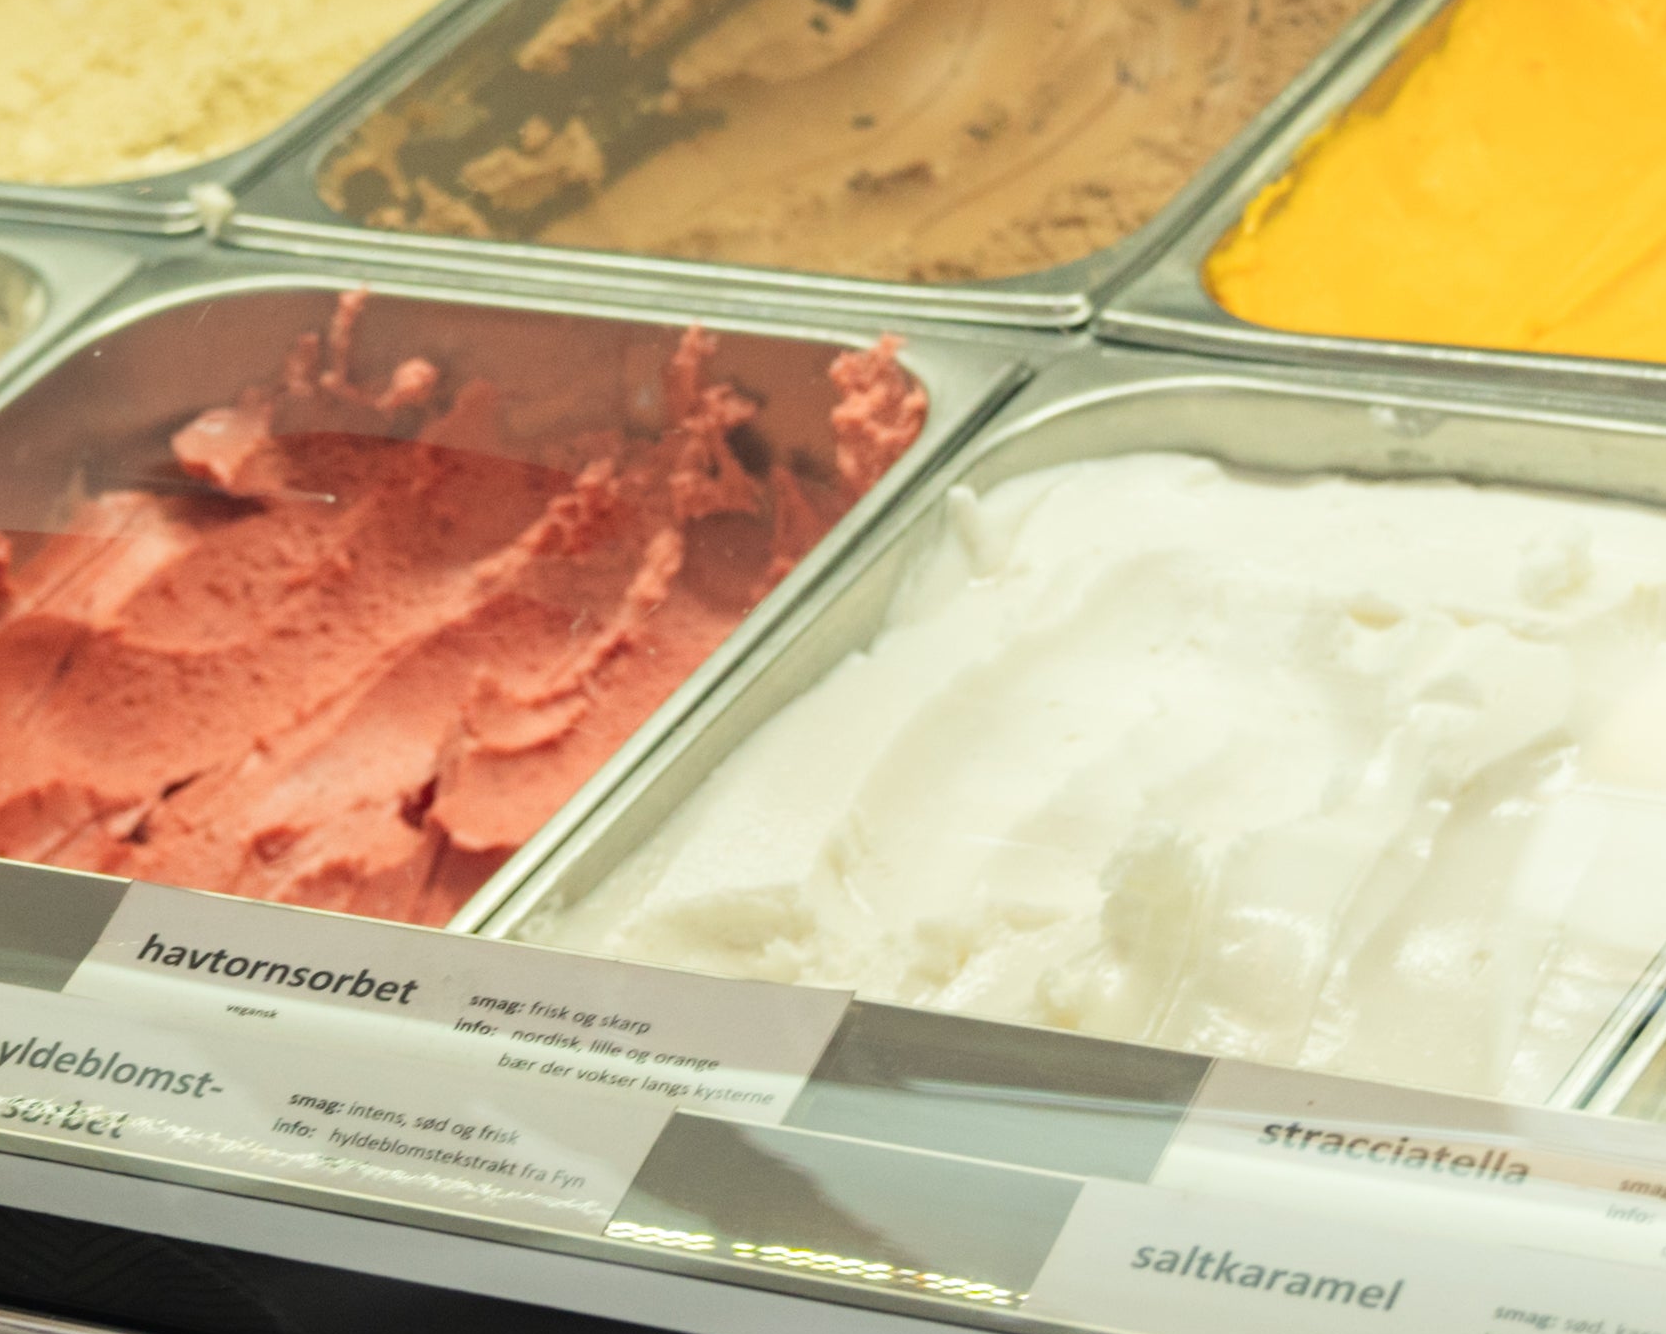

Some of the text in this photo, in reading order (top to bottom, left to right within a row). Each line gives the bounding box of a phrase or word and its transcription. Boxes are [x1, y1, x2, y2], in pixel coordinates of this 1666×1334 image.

[136, 933, 419, 1006] havtornsorbet
[226, 1000, 279, 1020] vegansk
[468, 992, 652, 1037] smag: frisk og skarp
[453, 1017, 721, 1073] info: nordisk, lille og orange
[498, 1052, 776, 1107] bær der vokser langs kysterne
[288, 1091, 522, 1147] smag: intens, sød og frisk
[271, 1116, 318, 1140] info:
[328, 1128, 519, 1177] hyldeblomstekstrakt
[519, 1162, 548, 1183] fra
[550, 1169, 587, 1190] Fyn
[1256, 1119, 1532, 1187] stracciatella
[1129, 1240, 1406, 1313] saltkaramel
[1492, 1302, 1559, 1332] smag:
